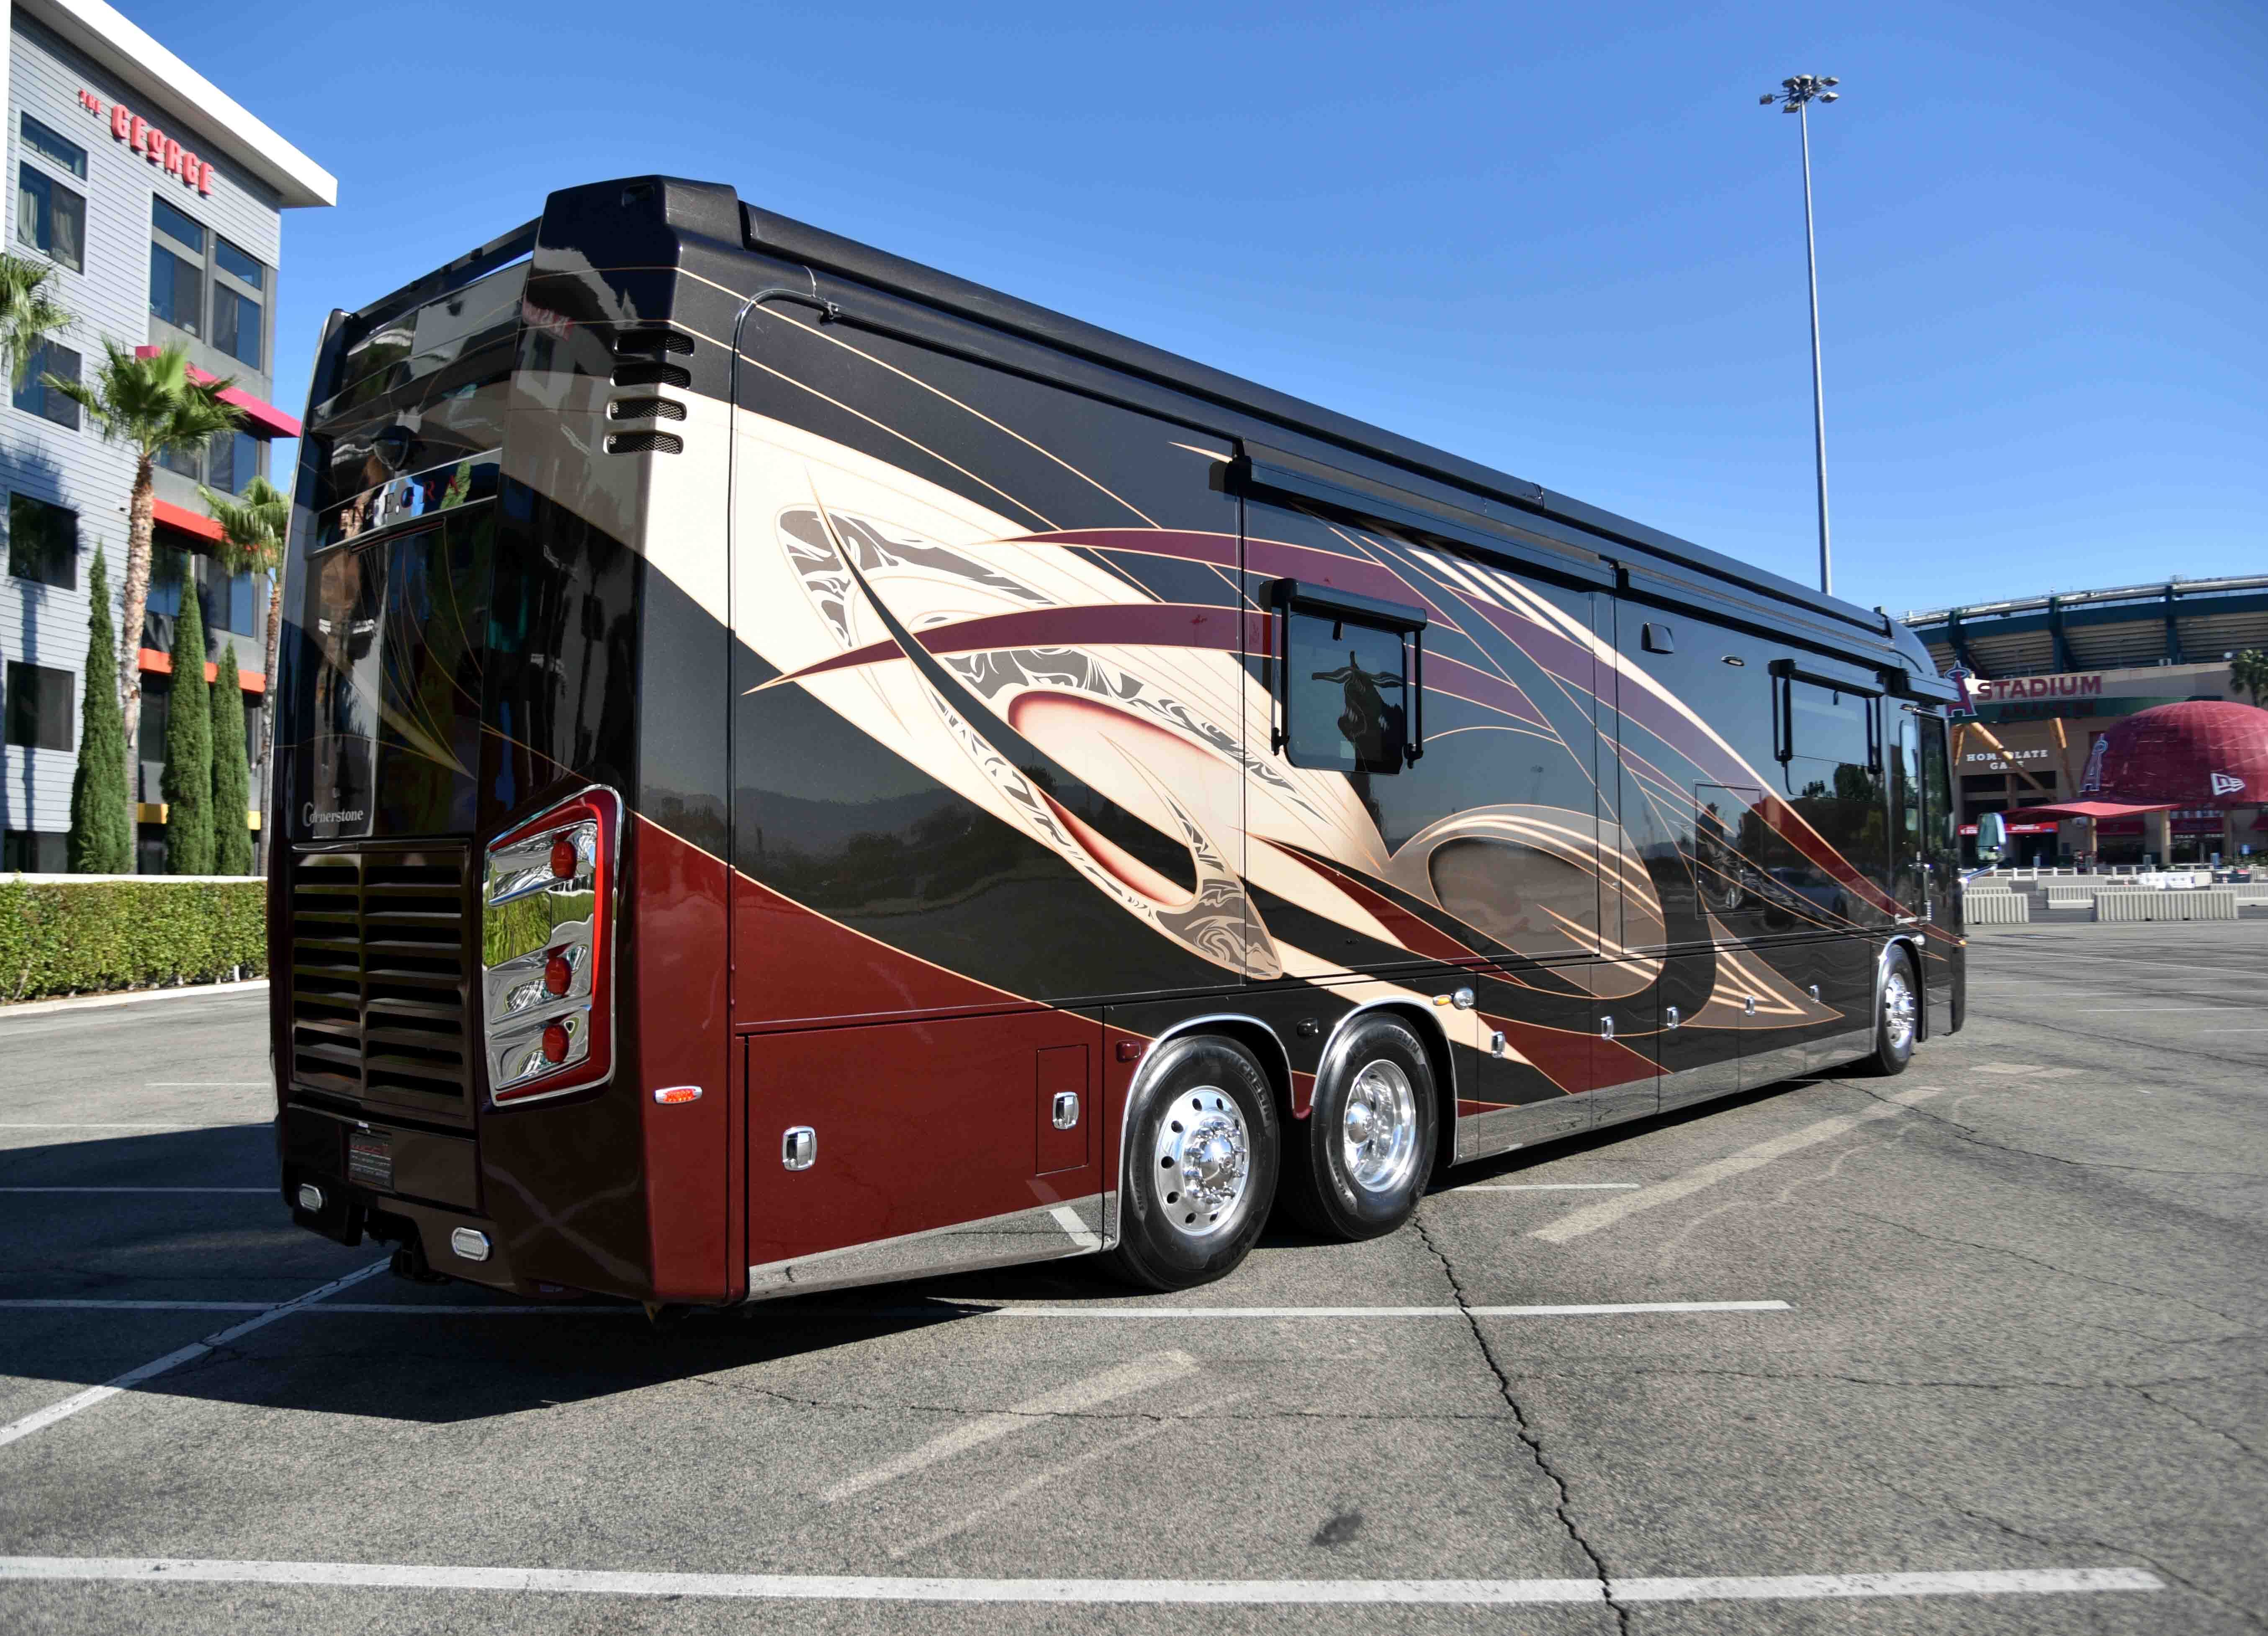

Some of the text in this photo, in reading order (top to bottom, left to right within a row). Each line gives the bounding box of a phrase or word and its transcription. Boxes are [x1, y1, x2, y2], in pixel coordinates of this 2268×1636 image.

[79, 89, 215, 196] THE GEORGE
[1976, 675, 2102, 701] STADIUM
[1966, 753, 2002, 762] HOM
[302, 801, 363, 827] Cornerstone
